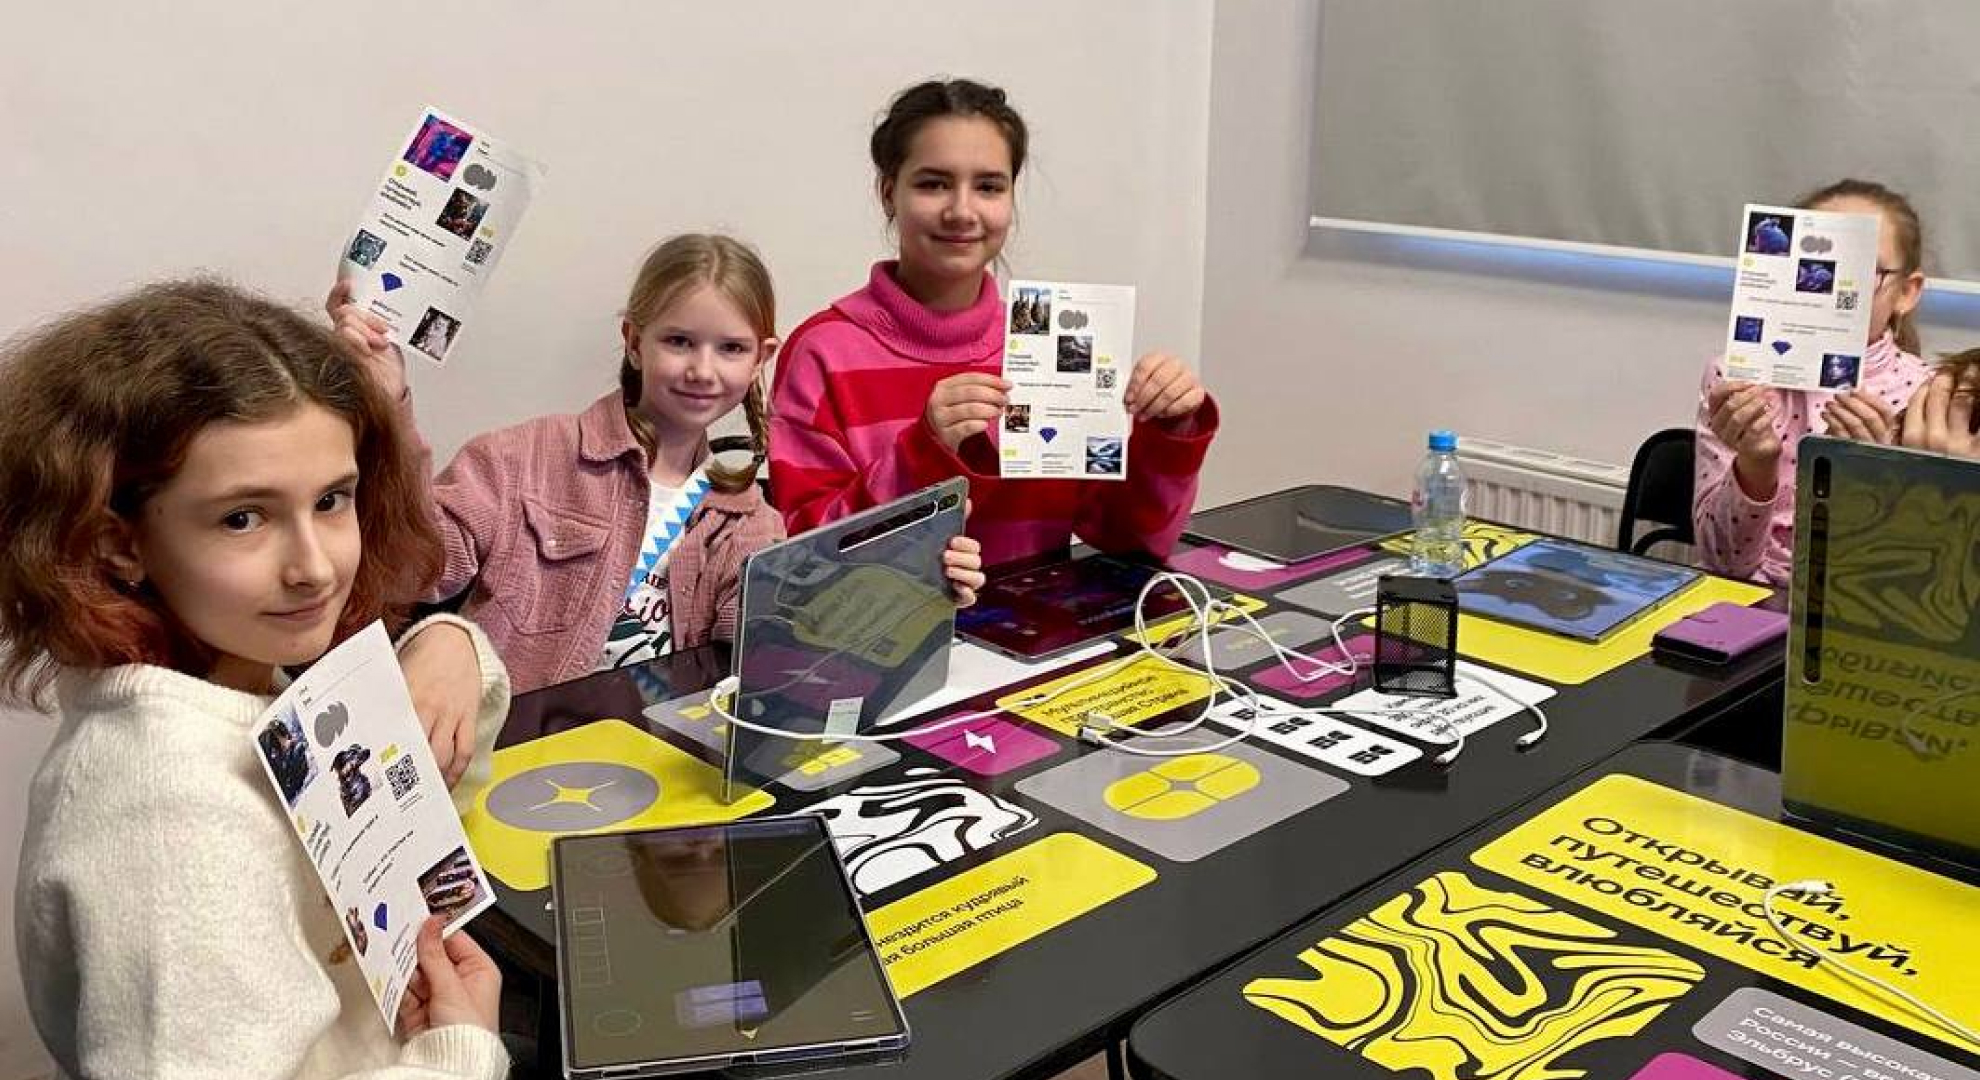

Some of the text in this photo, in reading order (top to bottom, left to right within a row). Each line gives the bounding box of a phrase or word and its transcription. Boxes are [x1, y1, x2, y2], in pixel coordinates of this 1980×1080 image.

[1550, 835, 1918, 976] путешествуй,
[1582, 817, 1850, 921] Открывай,
[901, 921, 976, 954] большая
[975, 898, 1024, 922] птица
[1520, 853, 1821, 968] влюбляйся
[1727, 1029, 1834, 1079] Эльбрус
[1739, 1018, 1832, 1059] России
[1753, 1007, 1945, 1080] Самая высока
